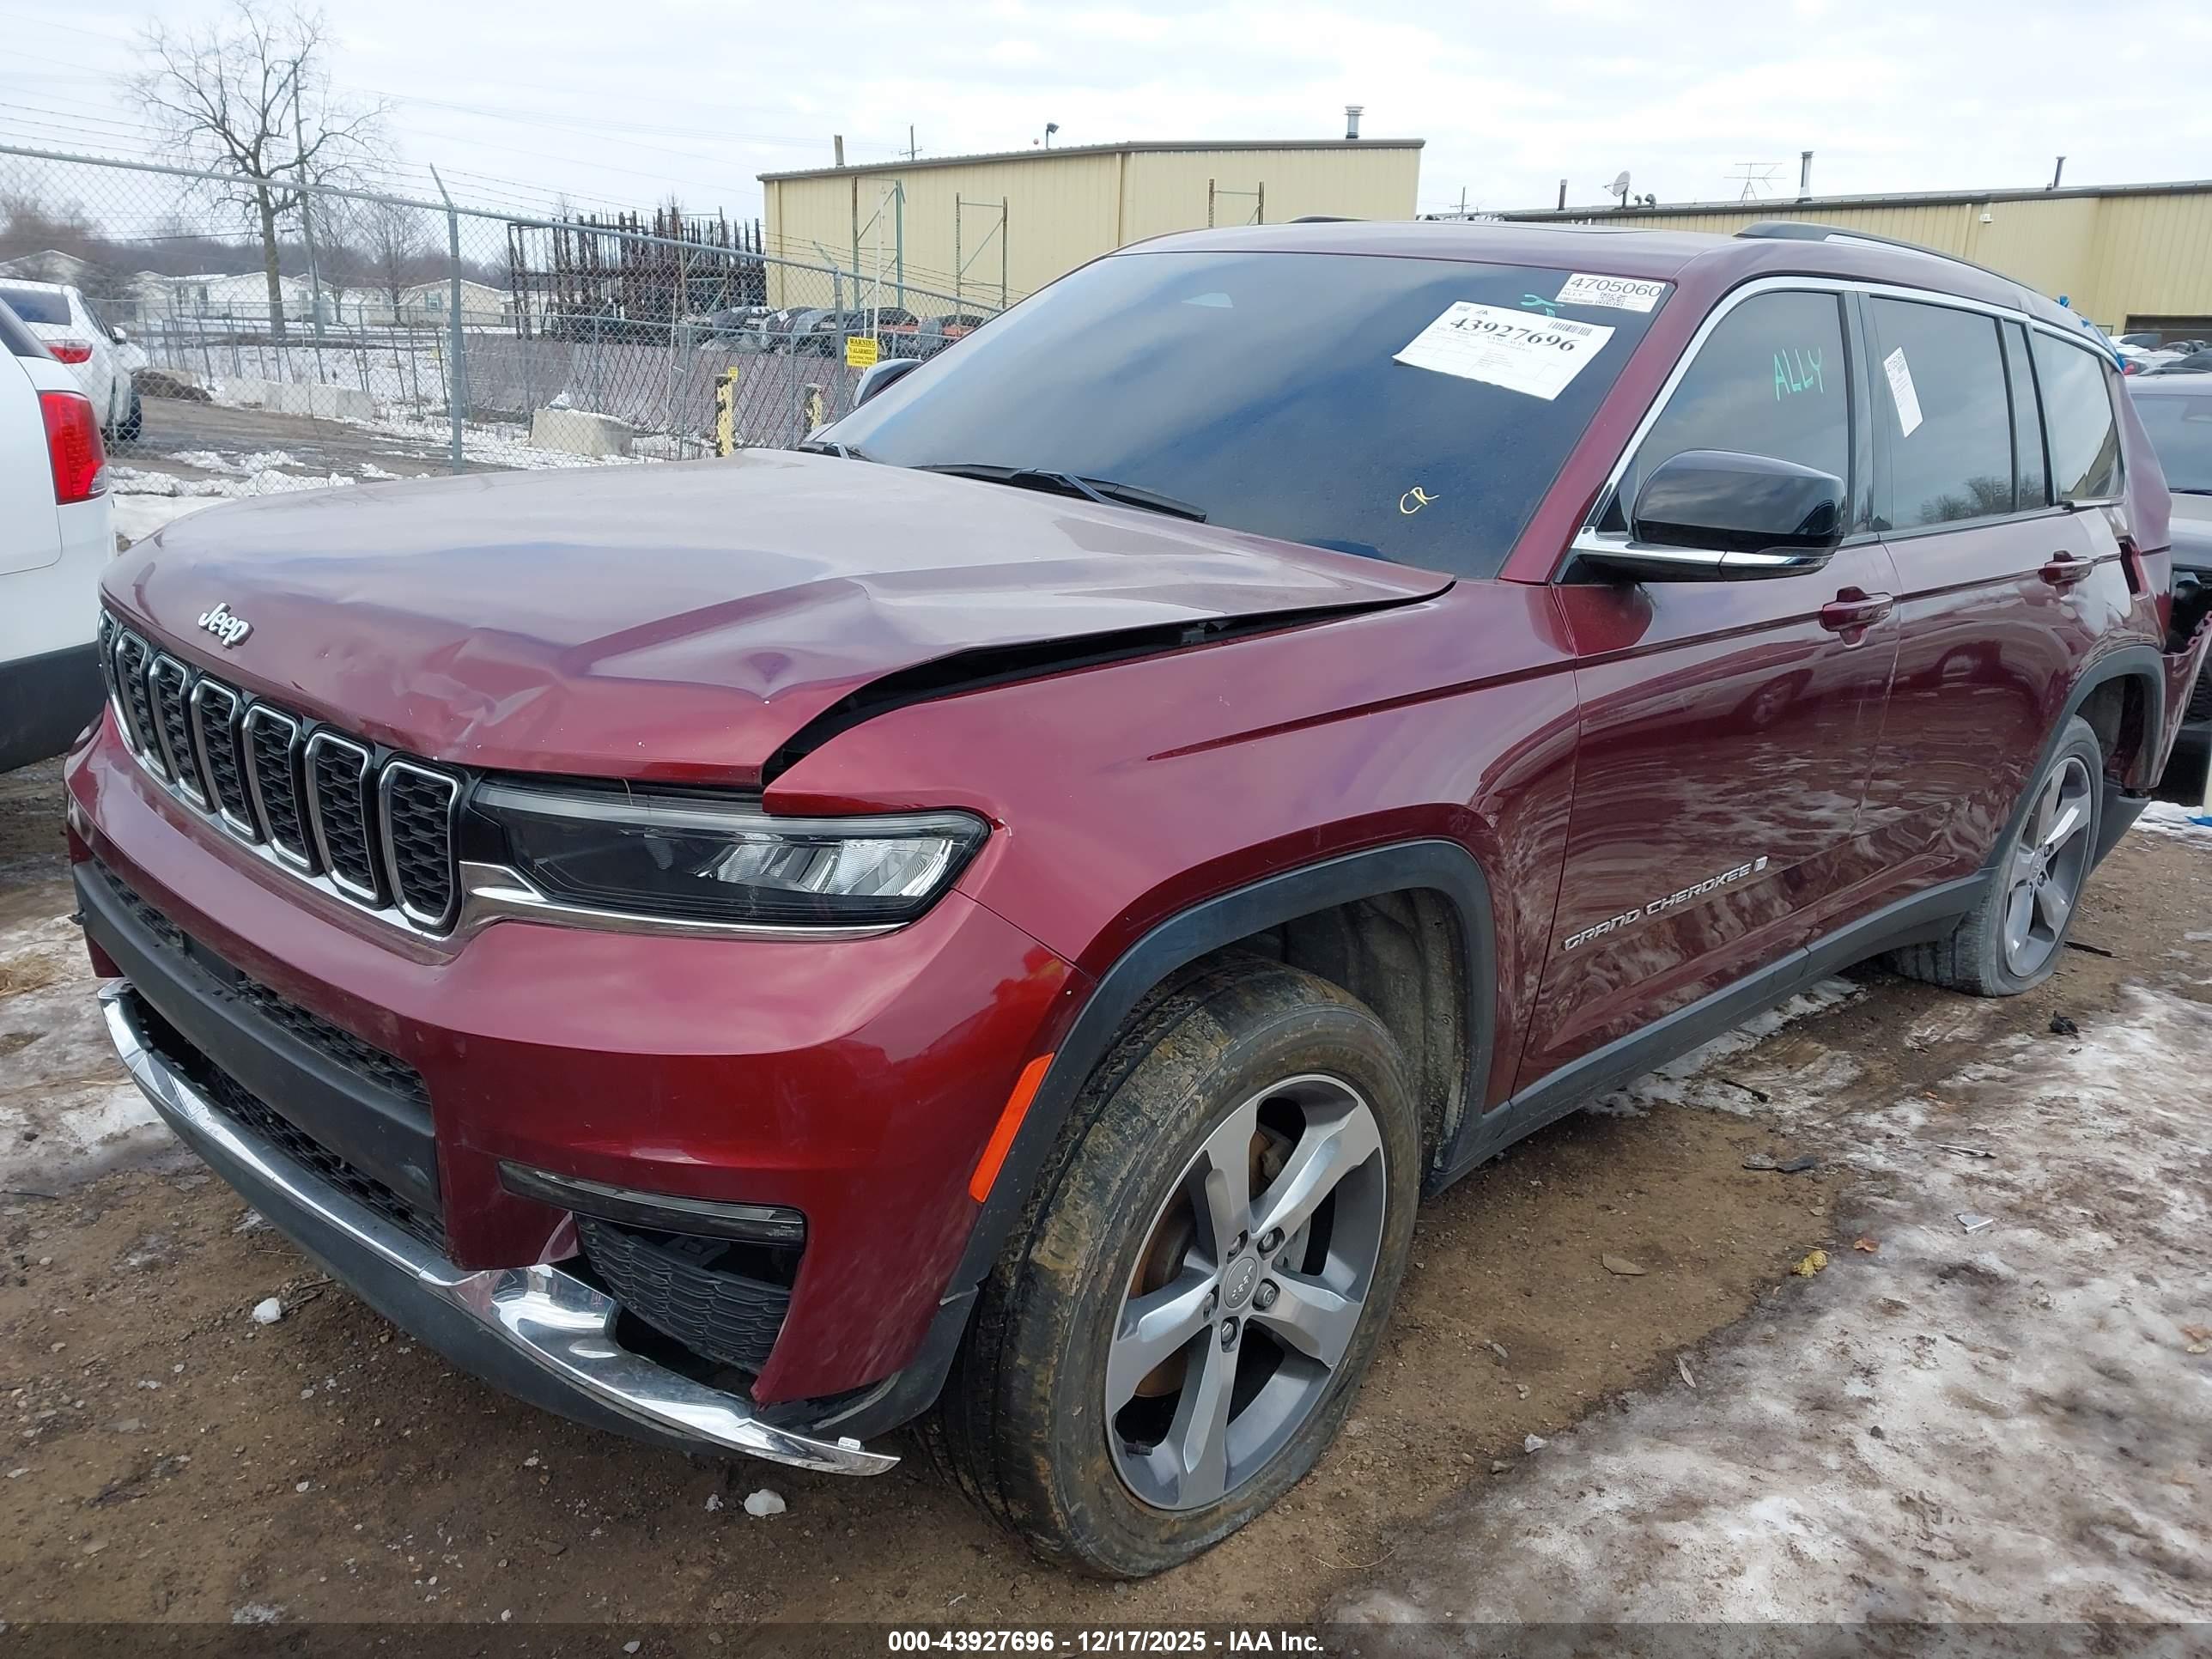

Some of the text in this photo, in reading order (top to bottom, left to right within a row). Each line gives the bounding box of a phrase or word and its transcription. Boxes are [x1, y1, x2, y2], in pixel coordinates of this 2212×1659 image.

[1571, 276, 1662, 297] 4705060
[849, 338, 875, 347] WARNING
[1449, 317, 1580, 351] 43927696
[1773, 346, 1824, 402] ALLY
[198, 602, 254, 649] Jeep
[1562, 863, 1753, 951] GRAND CHEROKEE
